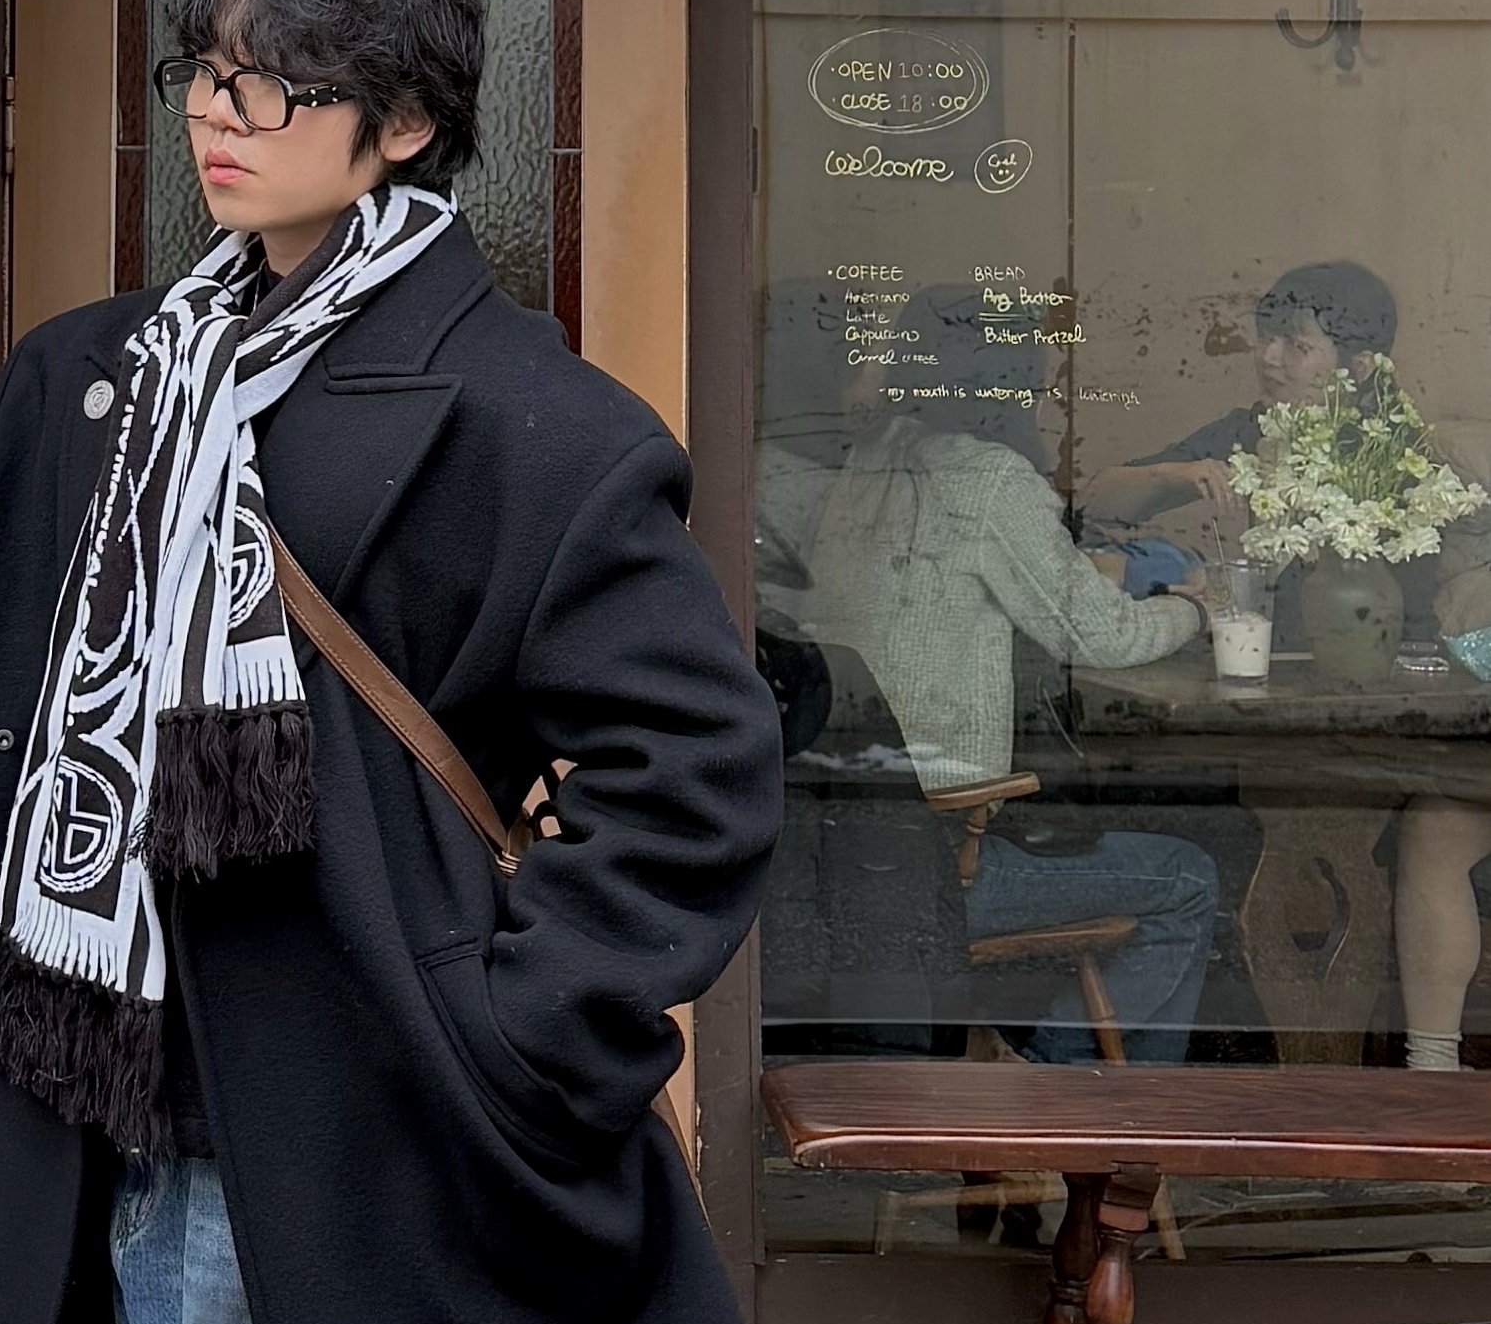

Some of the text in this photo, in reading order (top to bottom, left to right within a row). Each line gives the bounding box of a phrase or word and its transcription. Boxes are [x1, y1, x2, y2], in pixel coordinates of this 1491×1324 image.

[838, 61, 964, 81] OPEN 10:00
[841, 93, 968, 112] CLOSE 18:00
[836, 265, 904, 282] COFFEE
[974, 266, 1026, 282] BREAD
[846, 309, 890, 324] Latte
[1033, 324, 1087, 345] Pretzel
[954, 385, 967, 399] is
[1046, 385, 1063, 399] is
